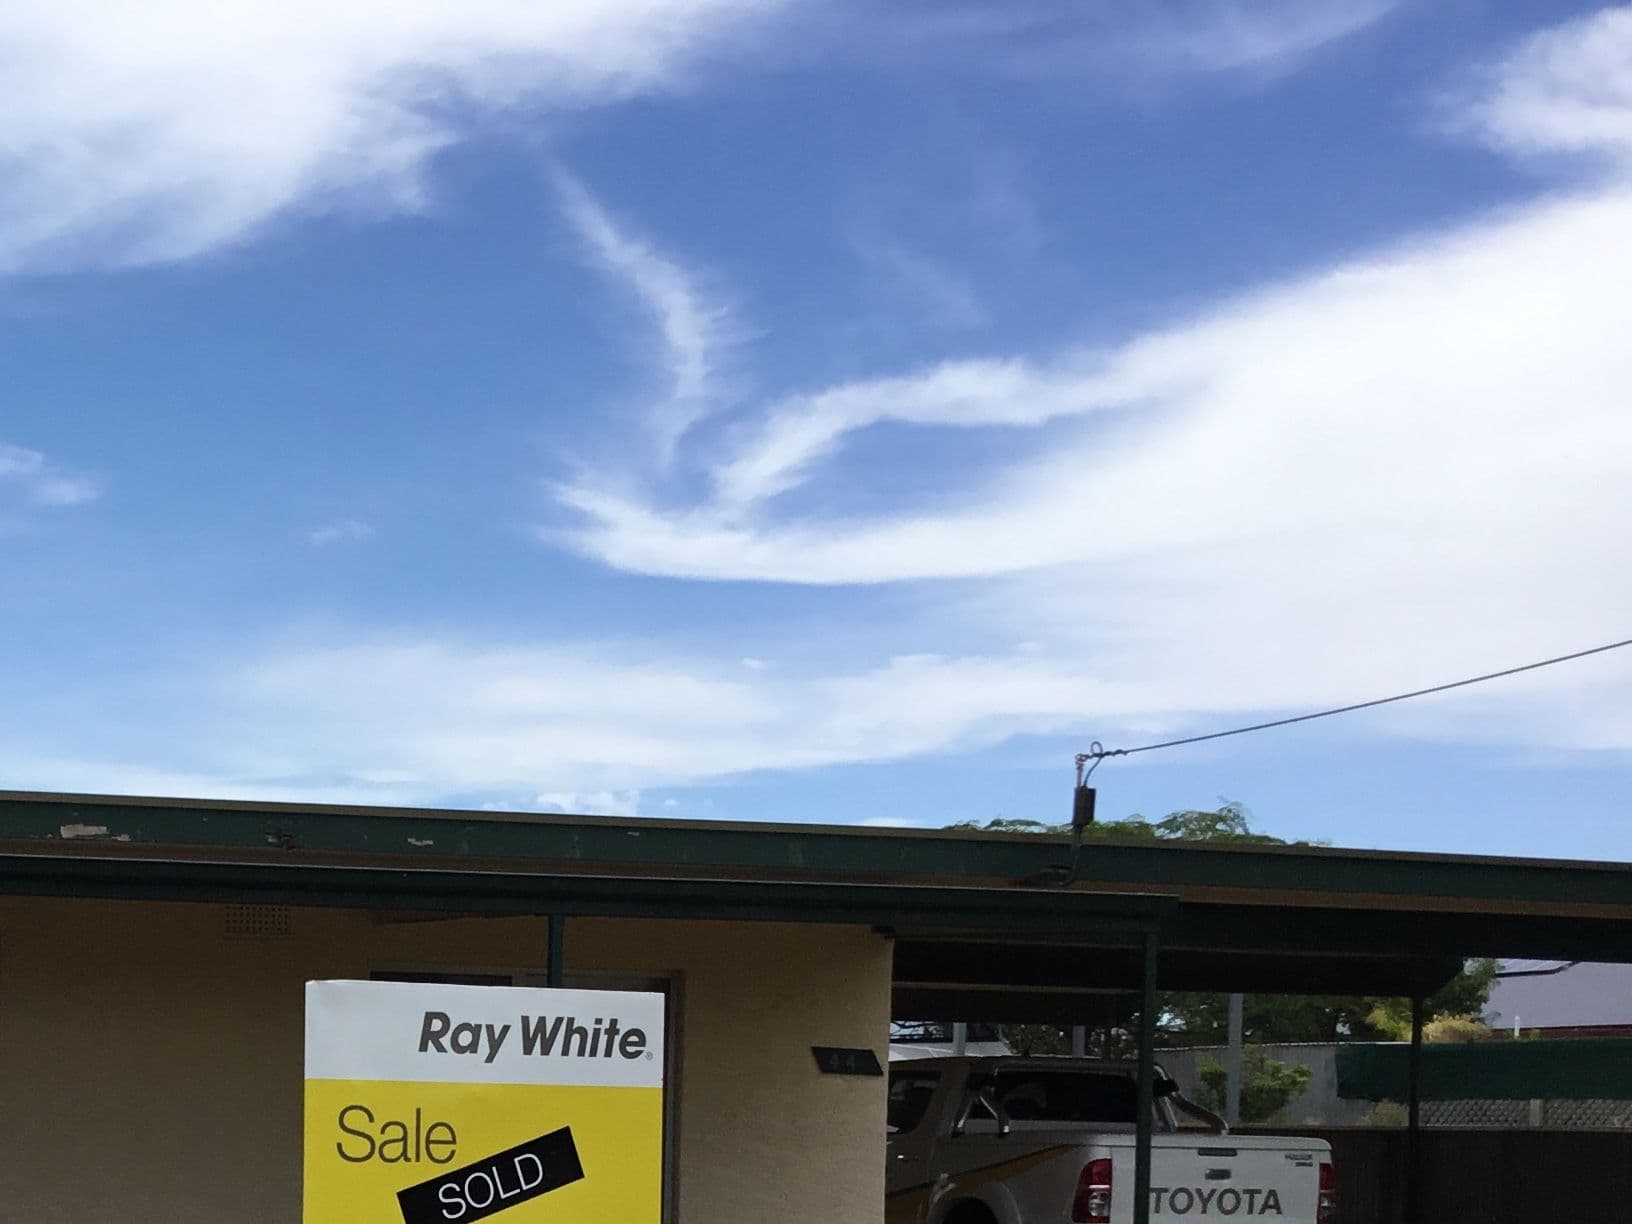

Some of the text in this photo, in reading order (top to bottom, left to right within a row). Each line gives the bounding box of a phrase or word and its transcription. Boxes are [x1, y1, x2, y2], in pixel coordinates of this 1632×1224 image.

[418, 1011, 647, 1064] Ray White
[336, 1104, 457, 1165] Sale
[437, 1152, 544, 1220] SOLD
[1150, 1187, 1282, 1215] TOYOTA
